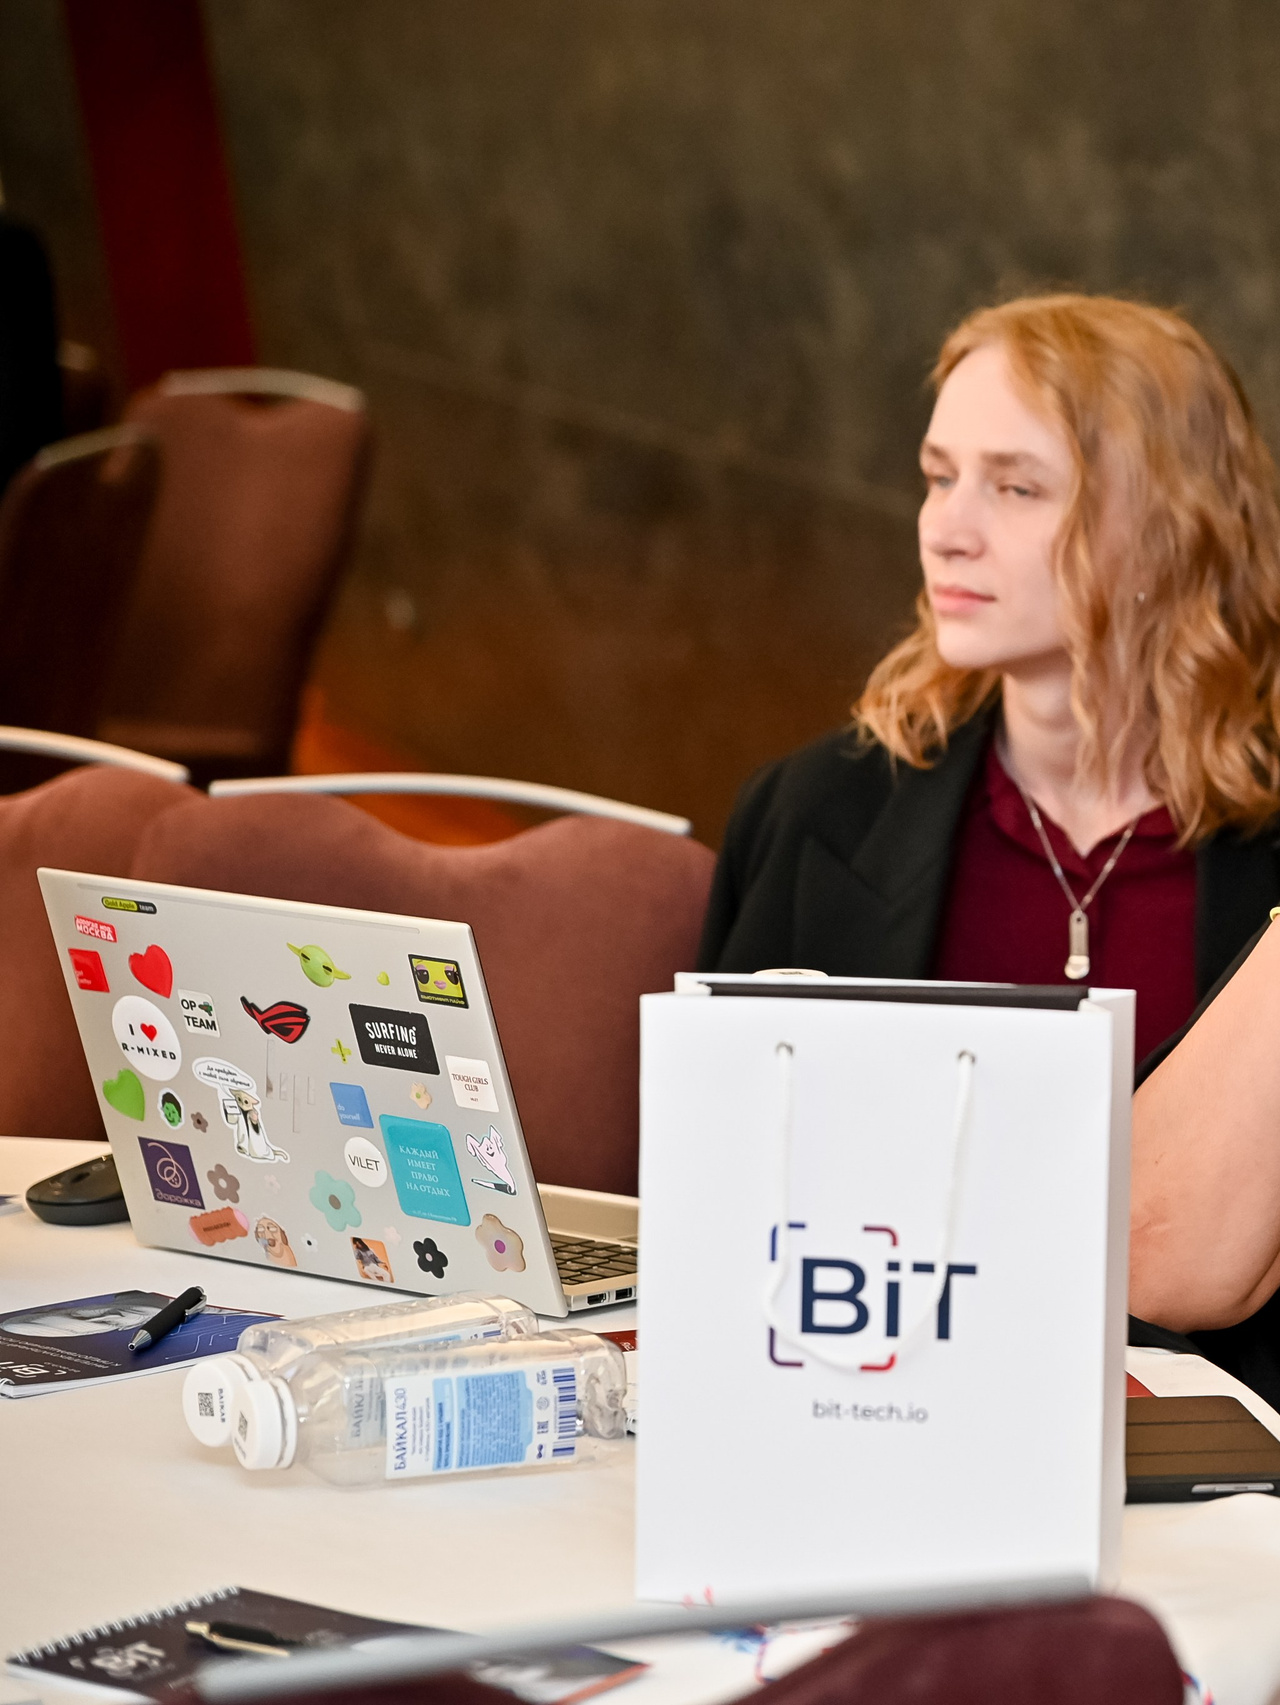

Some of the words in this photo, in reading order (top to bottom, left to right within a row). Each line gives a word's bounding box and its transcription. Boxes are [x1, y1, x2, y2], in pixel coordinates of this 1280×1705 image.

[139, 903, 154, 912] team
[76, 923, 115, 942] МОСКВА
[180, 998, 197, 1012] OP
[128, 1023, 135, 1036] I
[183, 1014, 218, 1032] TEAM
[364, 1021, 418, 1046] SURFING
[121, 1042, 177, 1060] R-MIXED
[374, 1043, 397, 1056] NEVER
[397, 1046, 419, 1059] ALONE
[451, 1073, 472, 1084] TOUGH
[472, 1076, 489, 1086] GIRLS
[464, 1083, 480, 1093] CLUB
[398, 1145, 439, 1160] КАЖДЫЙ
[348, 1154, 380, 1172] VILET
[407, 1158, 437, 1171] ИМЕЕТ
[411, 1171, 439, 1183] ПРАВО
[405, 1182, 420, 1192] НА
[420, 1185, 451, 1197] ОТДЫХ
[800, 1257, 978, 1341] BiT
[811, 1399, 930, 1424] bit-tech.io
